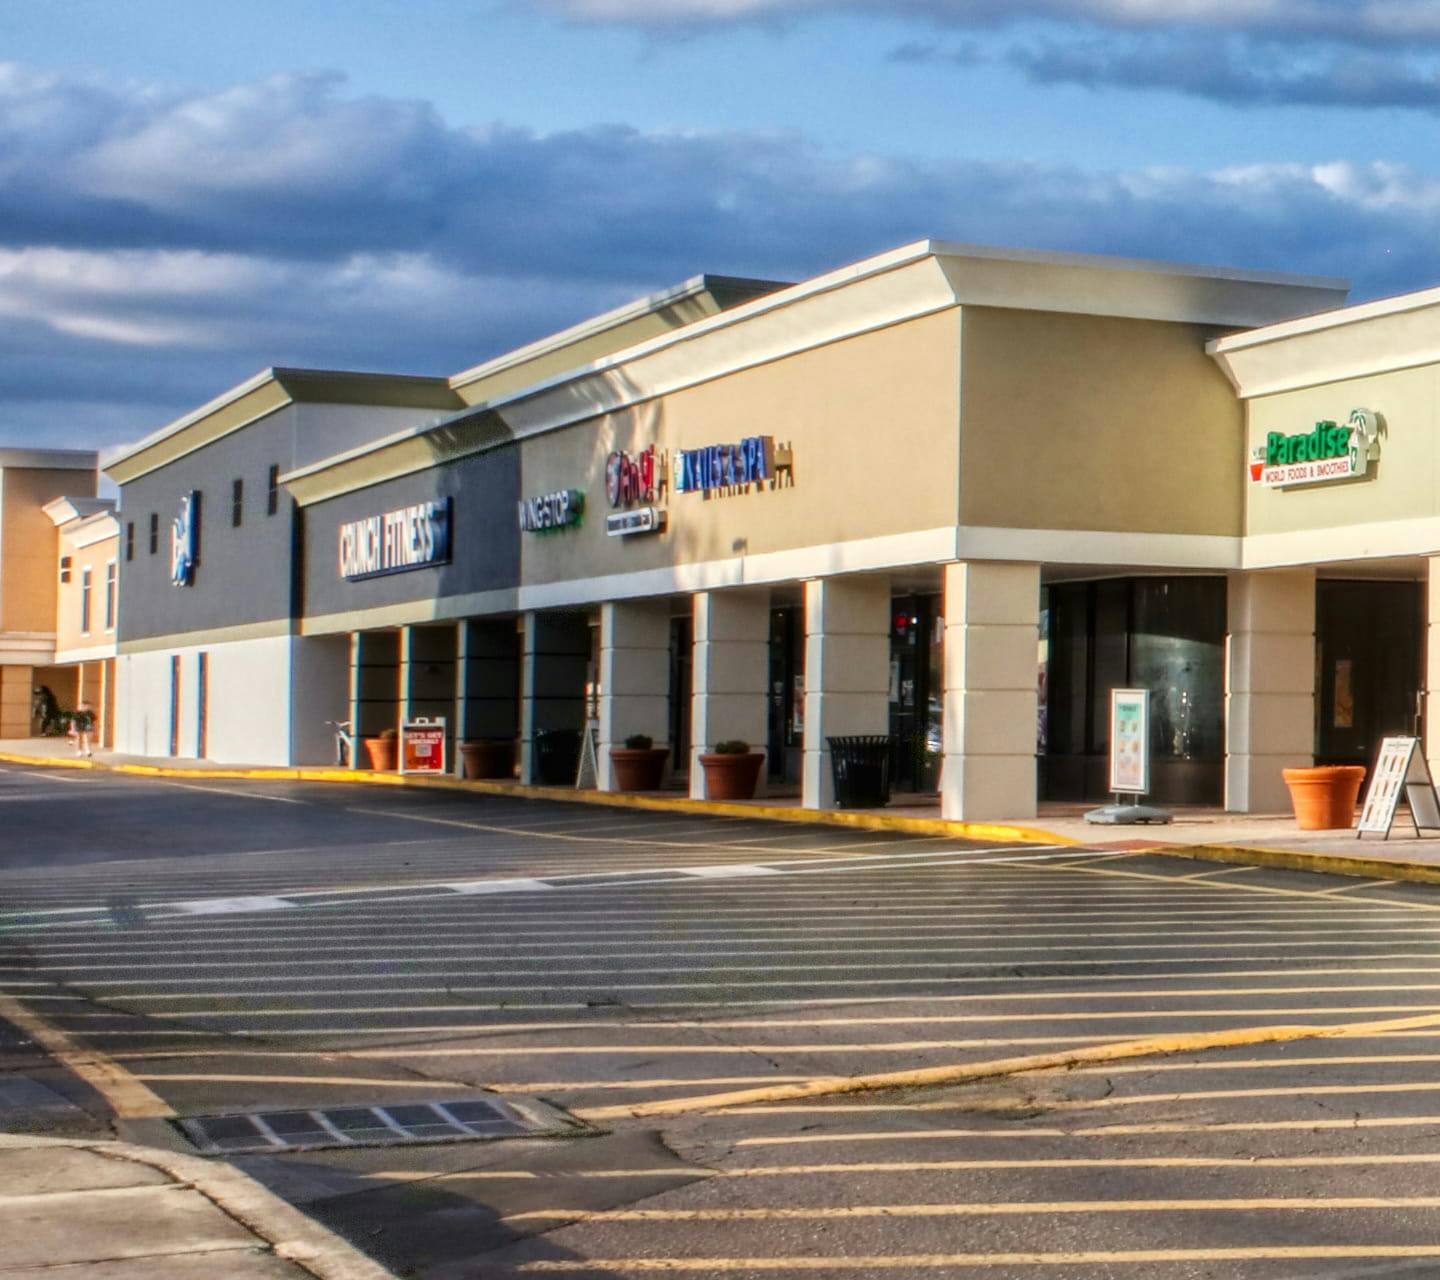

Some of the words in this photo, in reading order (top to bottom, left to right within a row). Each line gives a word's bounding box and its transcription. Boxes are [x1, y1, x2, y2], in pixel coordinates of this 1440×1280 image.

[1267, 420, 1351, 466] Paradise
[339, 515, 381, 578] CRUNCH
[383, 502, 435, 569] FITNESS
